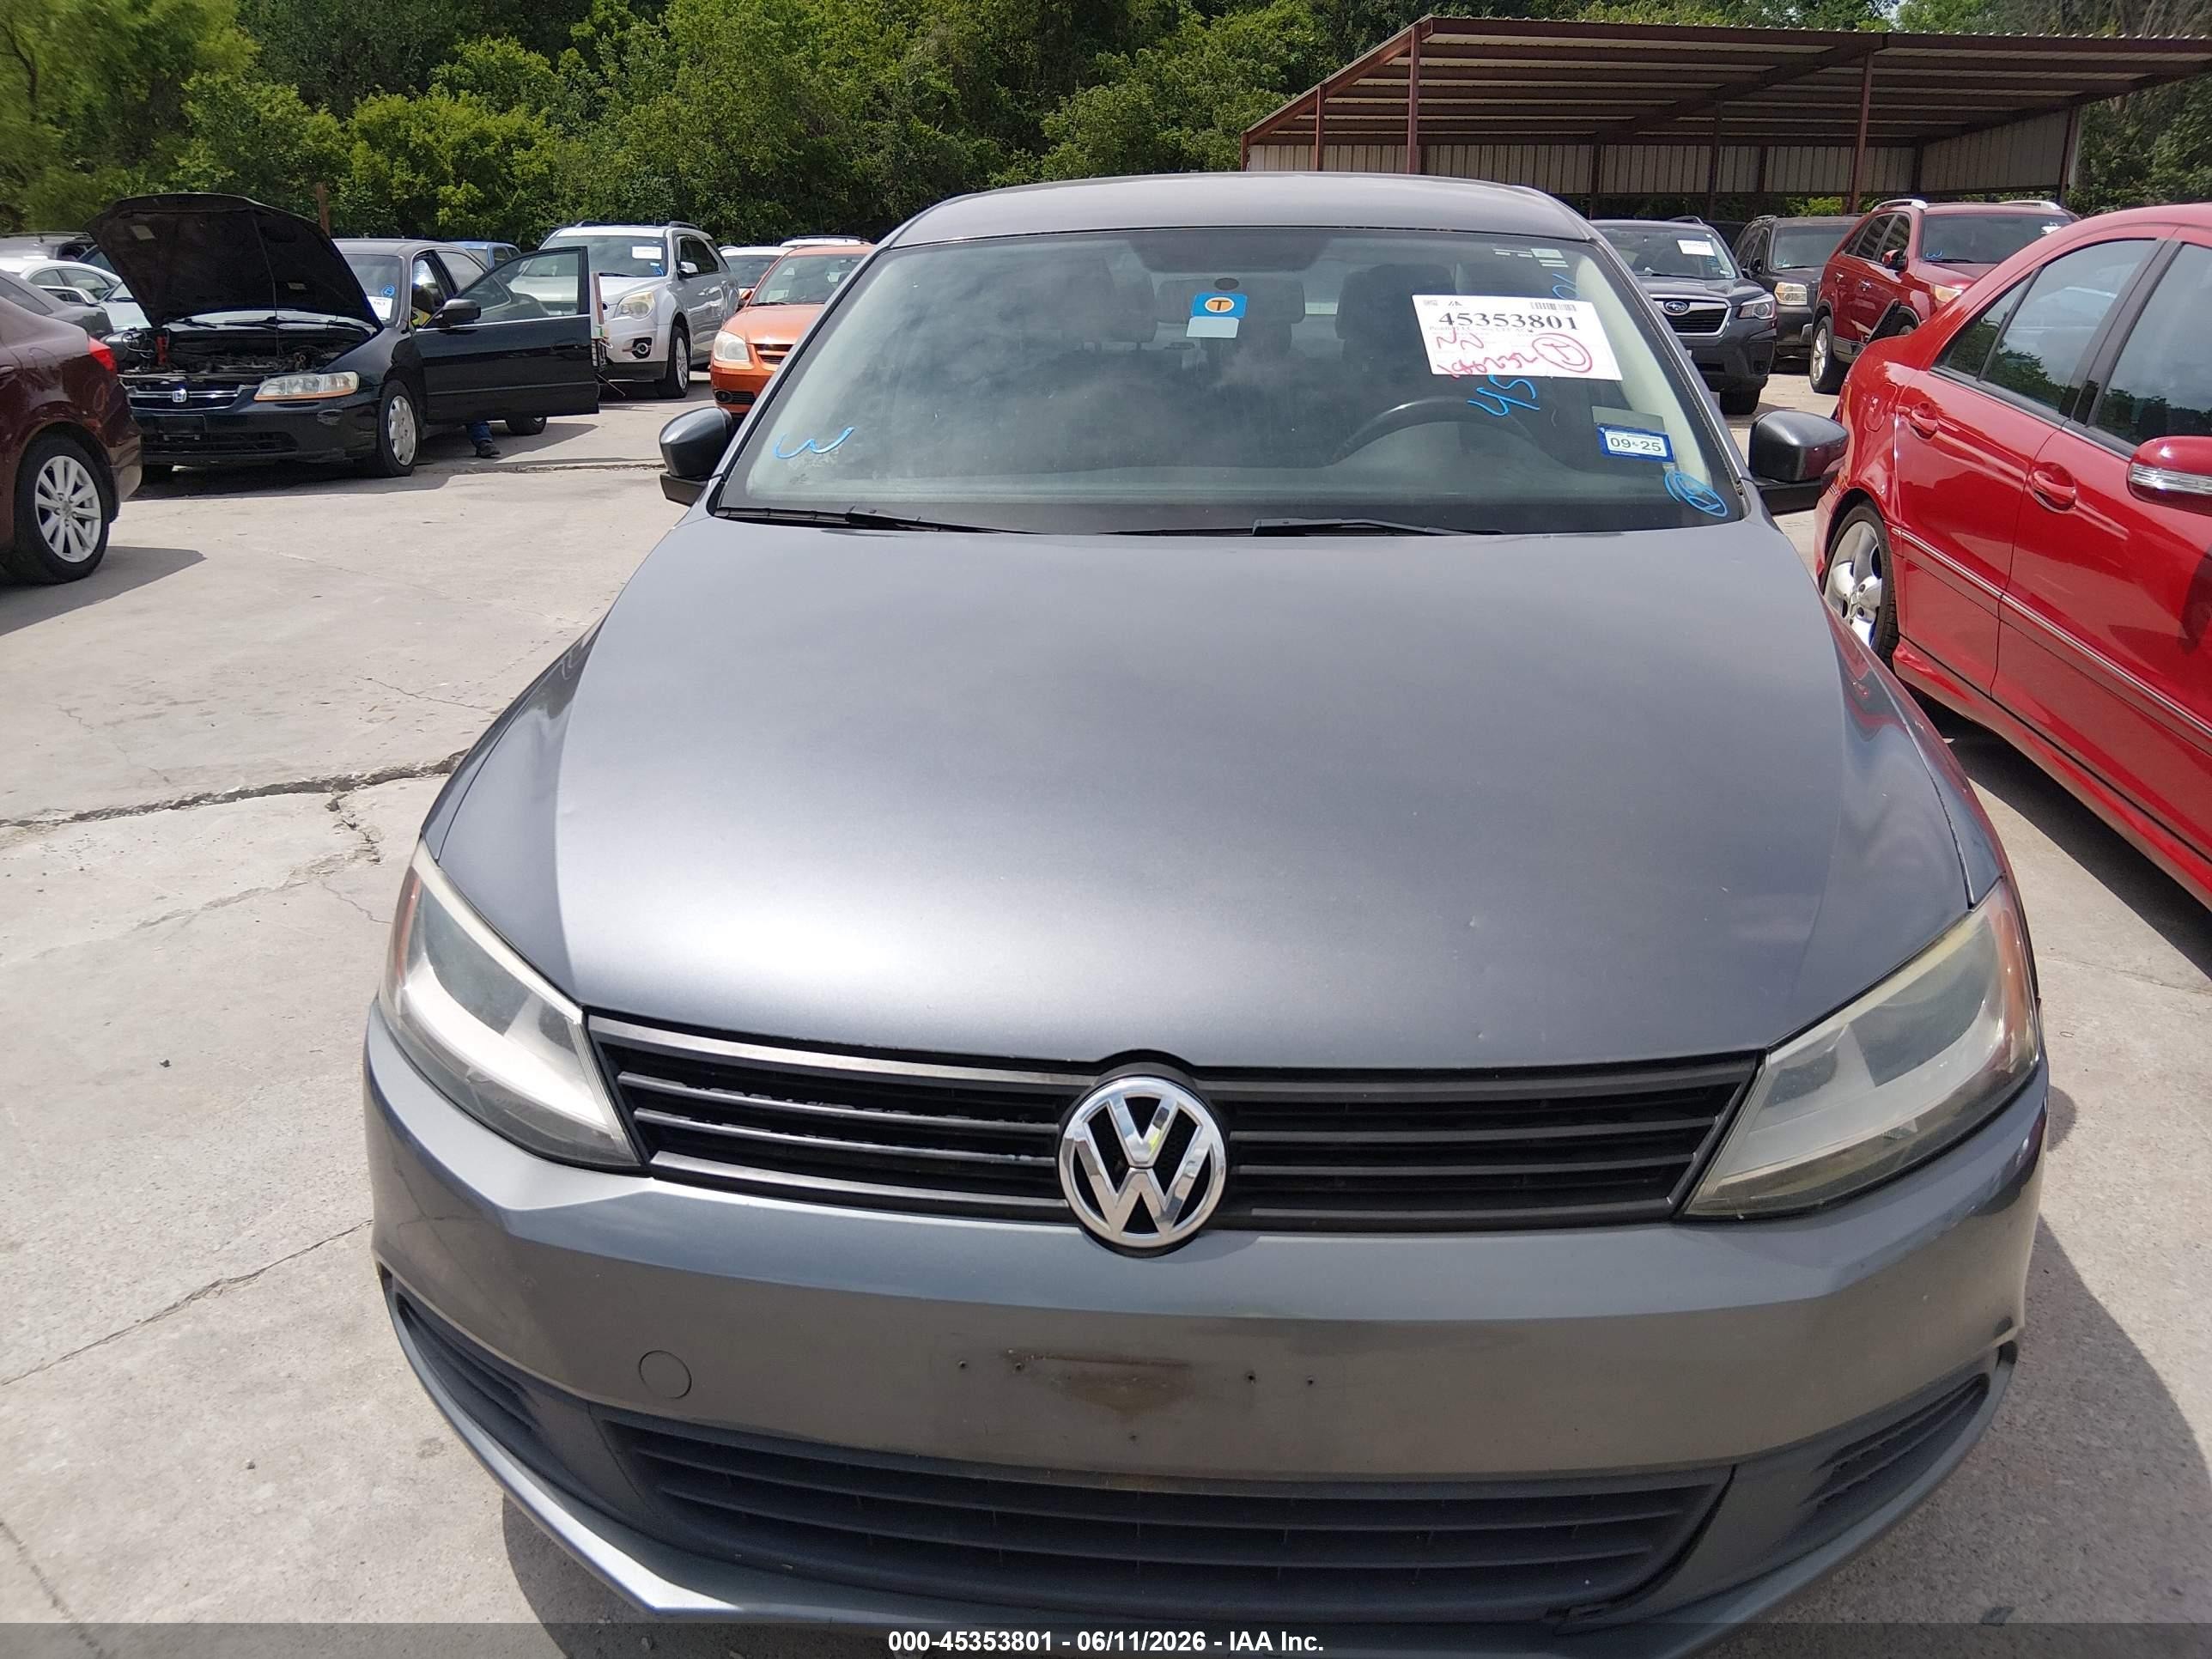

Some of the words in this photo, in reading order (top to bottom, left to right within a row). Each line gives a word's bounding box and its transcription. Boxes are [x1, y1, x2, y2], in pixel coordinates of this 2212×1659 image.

[1210, 299, 1231, 312] T
[1438, 312, 1580, 331] 45353801
[1058, 1075, 1227, 1248] VW
